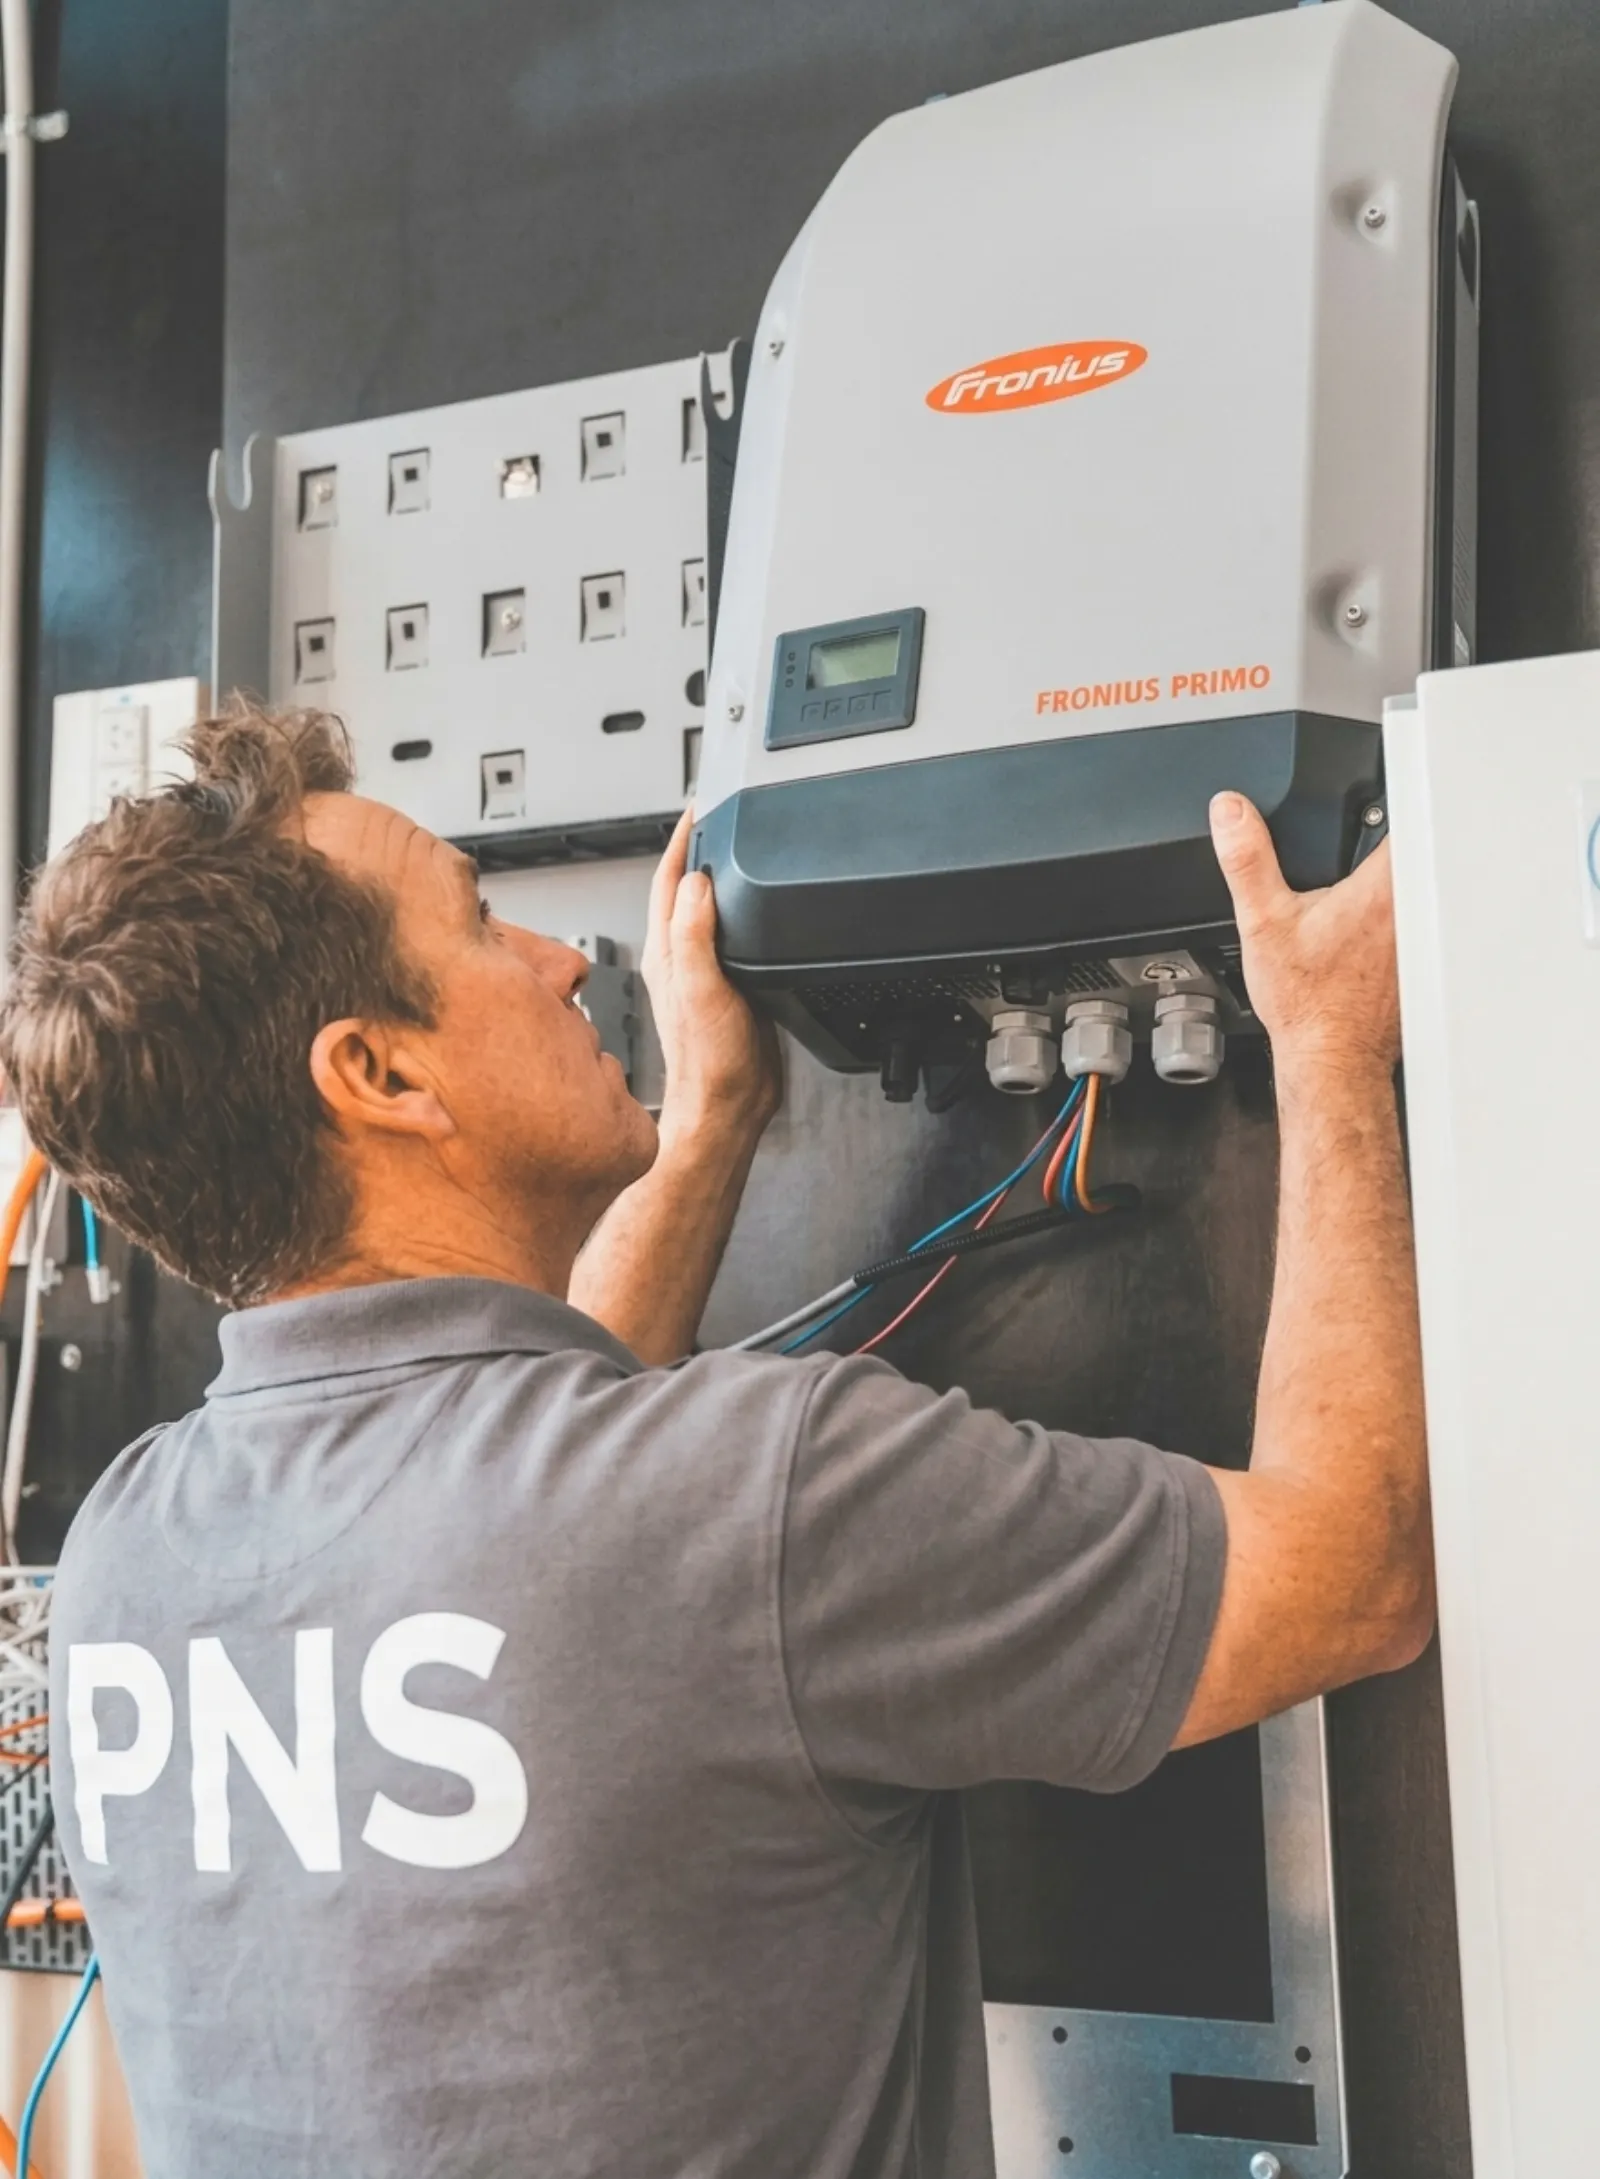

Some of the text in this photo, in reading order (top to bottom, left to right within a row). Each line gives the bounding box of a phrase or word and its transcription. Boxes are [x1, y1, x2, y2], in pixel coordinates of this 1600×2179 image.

[943, 350, 1129, 406] Fronius
[1036, 665, 1271, 714] FRONIUS PRIMO
[67, 1611, 528, 1872] PNS
